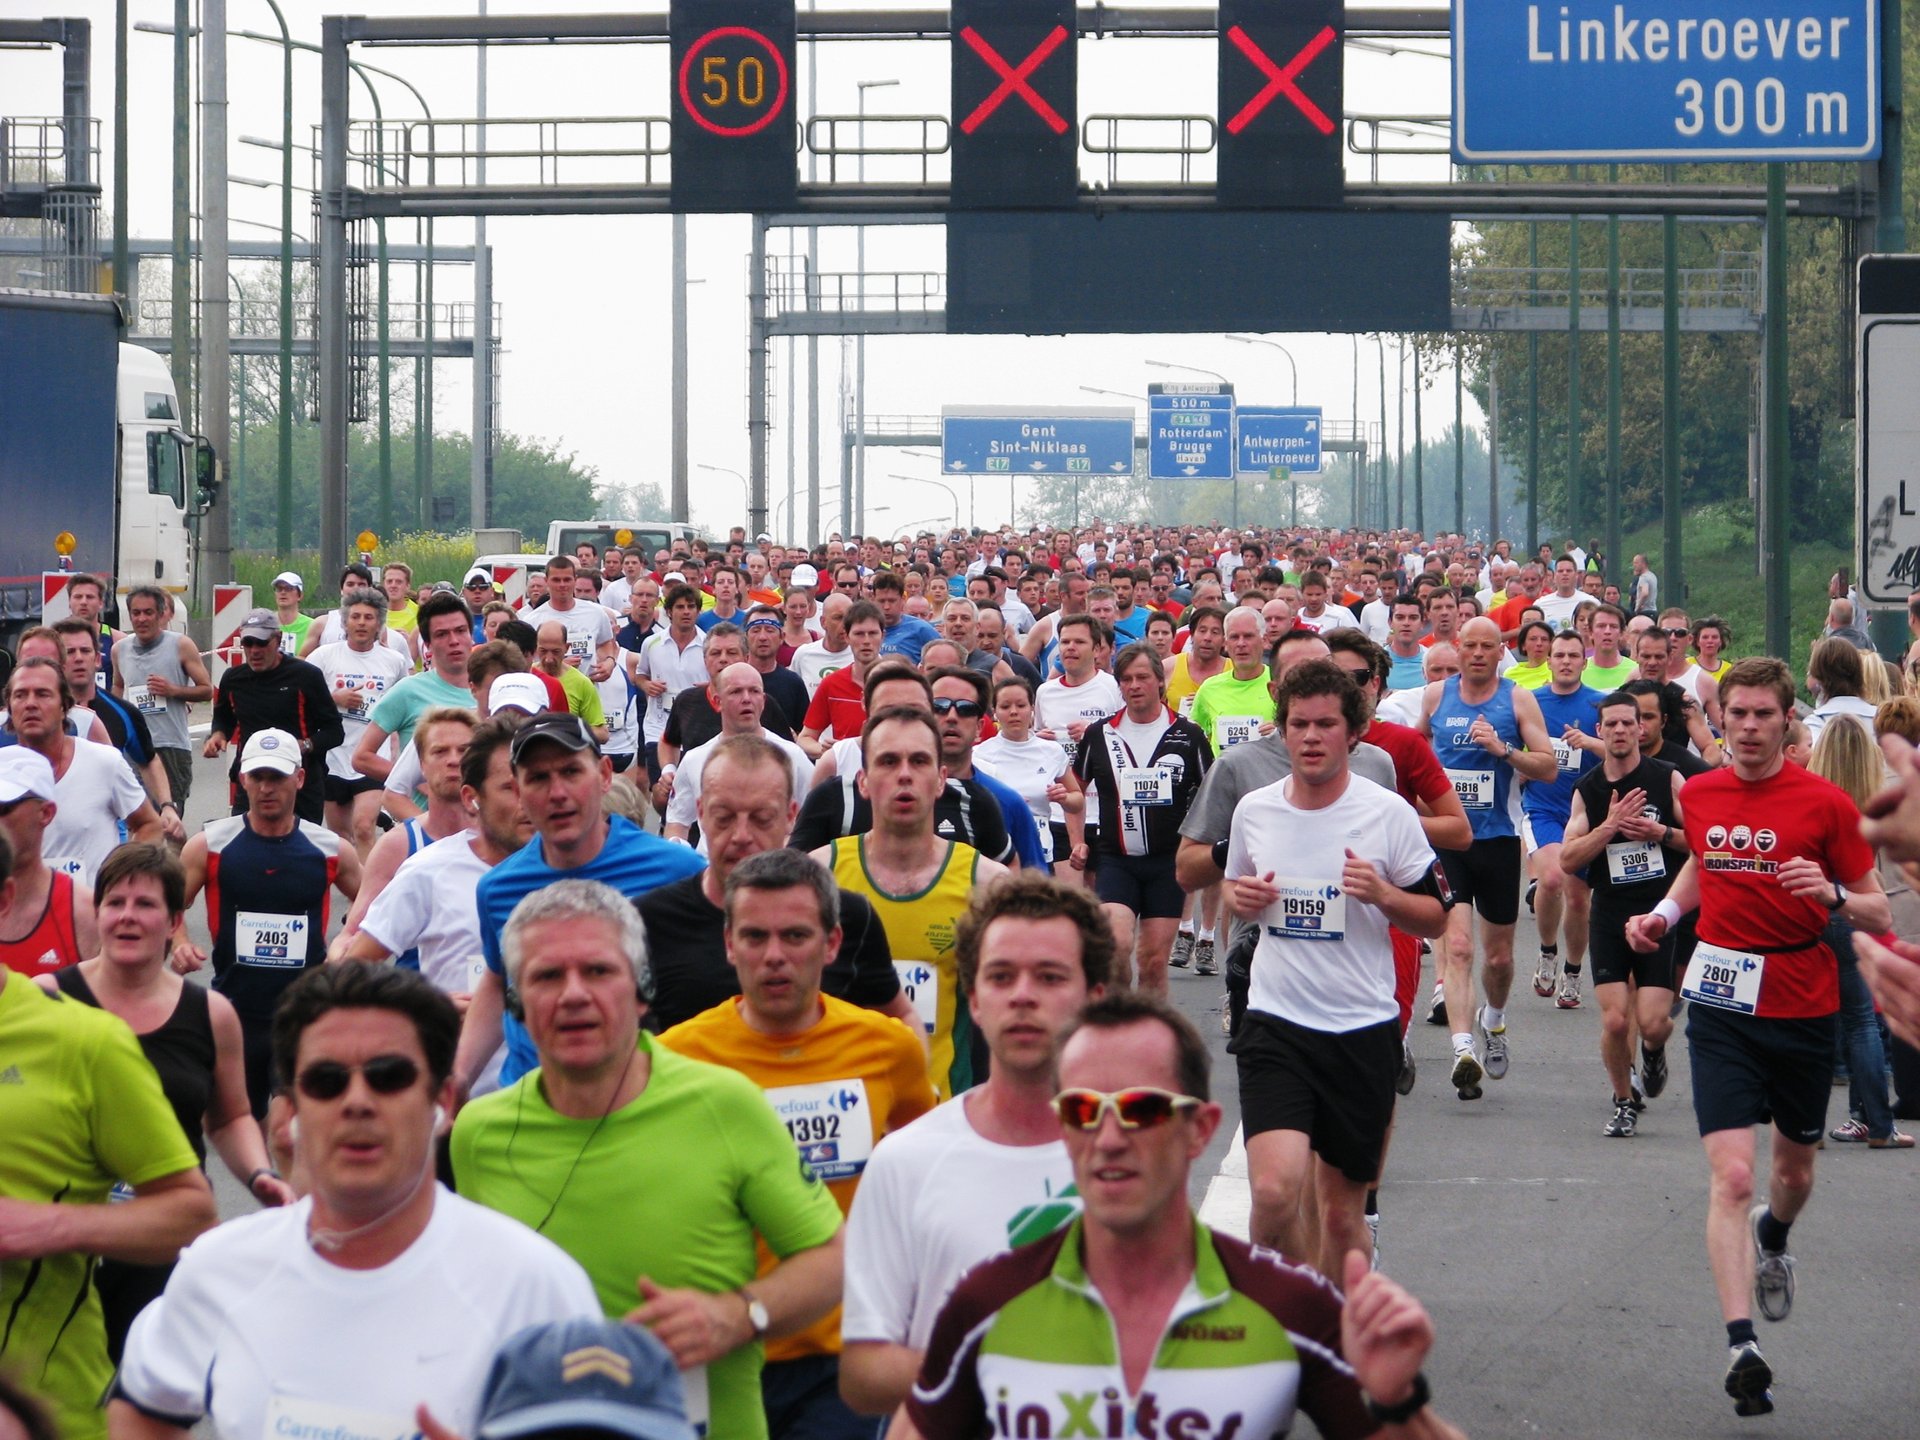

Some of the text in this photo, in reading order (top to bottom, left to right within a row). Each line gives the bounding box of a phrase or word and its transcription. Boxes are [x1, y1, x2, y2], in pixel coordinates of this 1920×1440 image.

[1528, 5, 1849, 61] Linkeroever
[702, 56, 765, 107] 50
[1674, 77, 1848, 135] 300 m
[1171, 397, 1210, 408] 500 m
[1021, 424, 1056, 437] Gent
[1159, 428, 1223, 438] Rotterdam
[990, 440, 1087, 454] Sint-Niklaas
[1169, 442, 1213, 454] Brugge
[1244, 435, 1312, 450] Antwerpen-
[988, 459, 1008, 470] E17
[1068, 459, 1088, 471] E17
[1251, 452, 1316, 465] Linkeroever
[1228, 726, 1249, 736] 6243
[1134, 780, 1159, 790] 11074
[1455, 782, 1478, 792] 6818
[1621, 852, 1648, 866] 5306
[1704, 857, 1778, 873] IRONSPRINT
[1282, 898, 1325, 916] 19159
[240, 919, 282, 929] Carrefour
[255, 930, 288, 946] 2403
[1703, 963, 1737, 984] 2807
